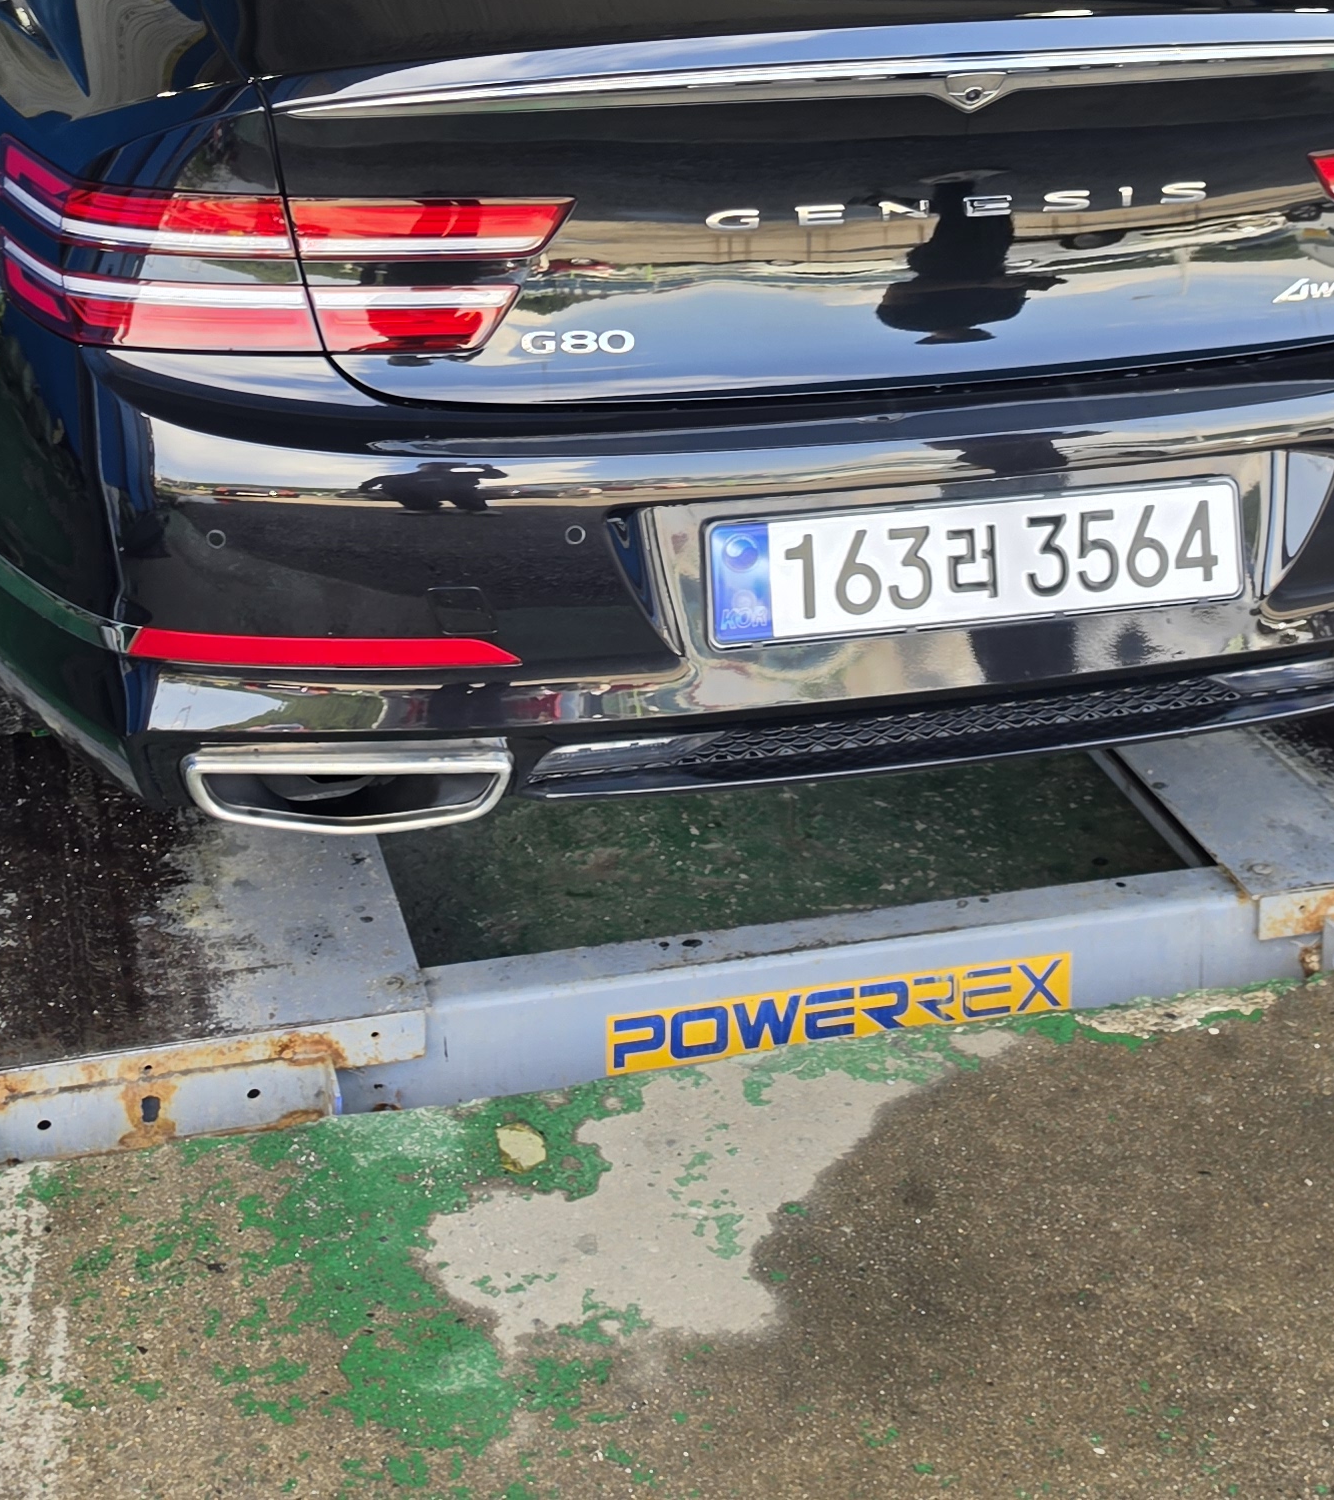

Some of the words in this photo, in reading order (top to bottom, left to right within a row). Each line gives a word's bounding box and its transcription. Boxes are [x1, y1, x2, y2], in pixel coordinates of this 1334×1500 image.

[705, 180, 1208, 231] GENESIS
[520, 329, 636, 355] G80
[783, 525, 999, 620] 163러
[1026, 500, 1220, 598] 3564
[613, 958, 1063, 1068] POWERREX
